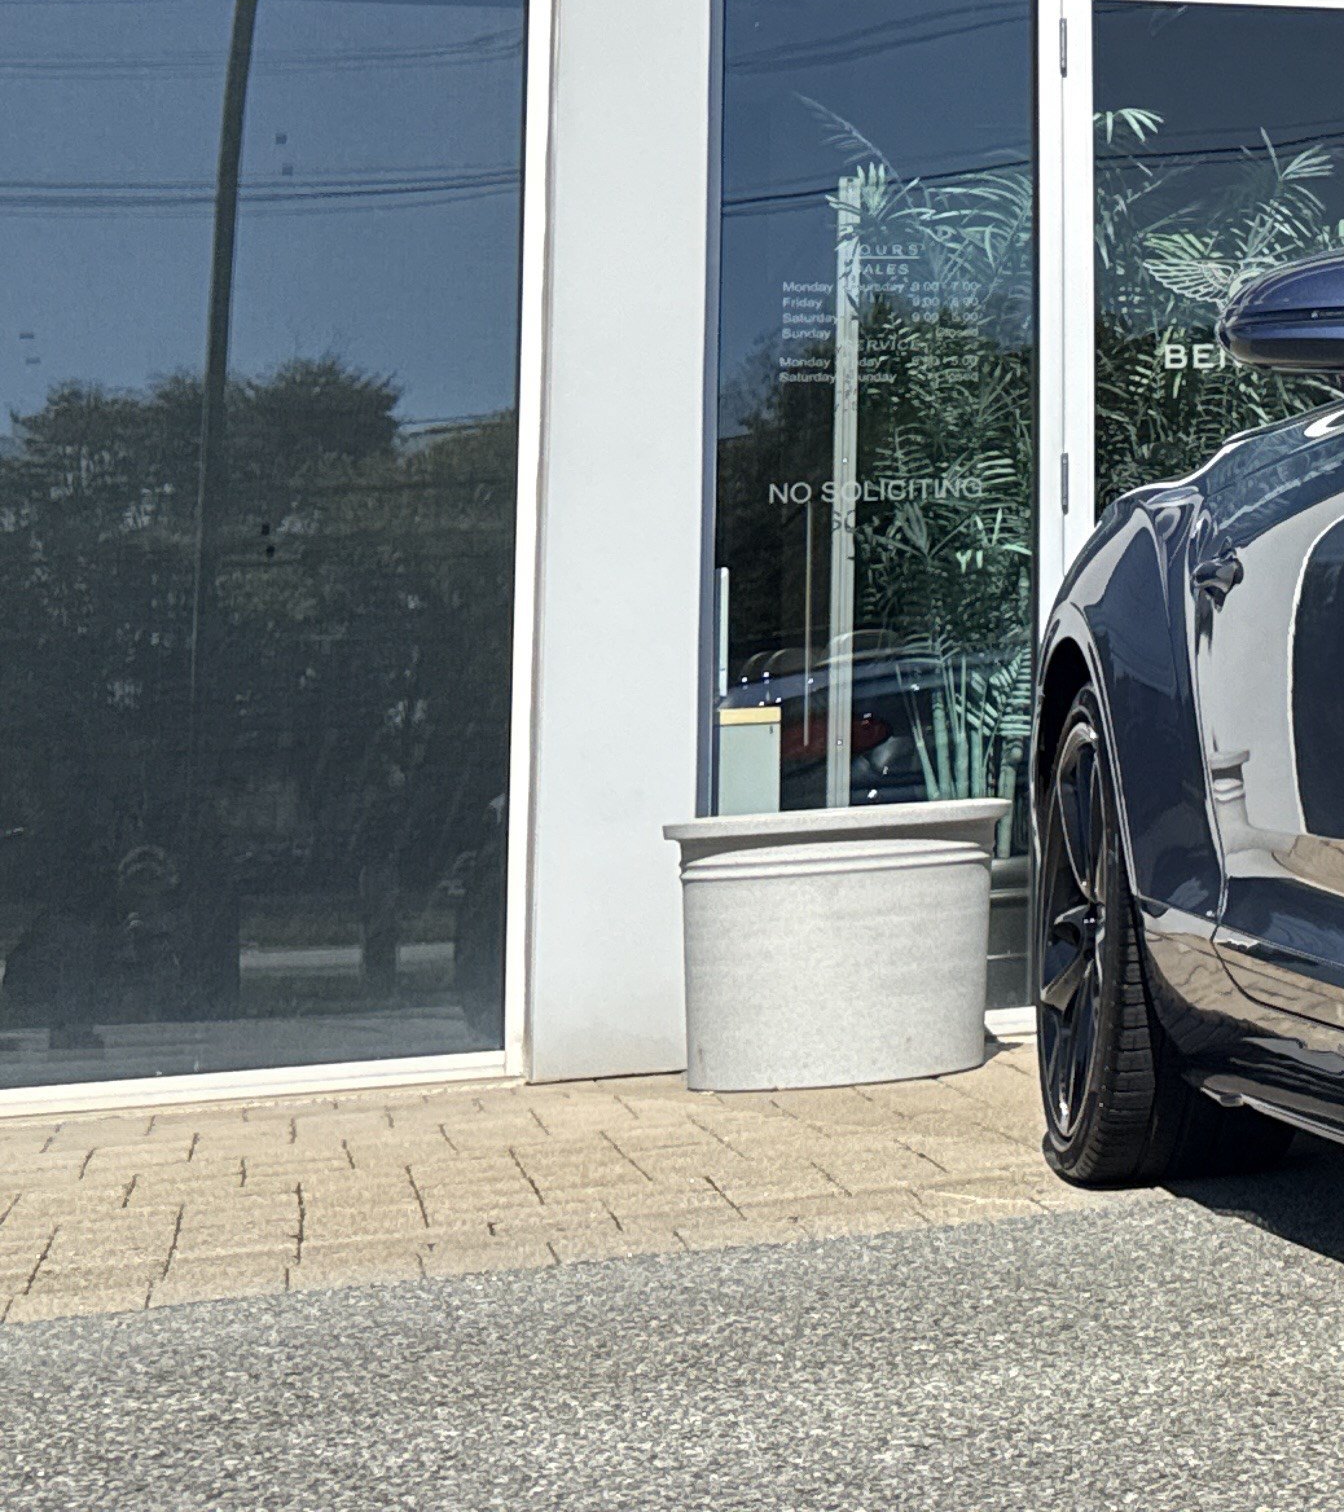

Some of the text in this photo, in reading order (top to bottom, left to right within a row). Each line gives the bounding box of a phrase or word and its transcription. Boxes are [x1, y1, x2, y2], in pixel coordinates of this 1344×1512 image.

[858, 244, 919, 256] OURS
[862, 263, 910, 275] ALES
[782, 282, 833, 294] Monday
[782, 298, 823, 310] Friday
[782, 313, 837, 325] Saturday
[781, 328, 831, 340] Sunday
[779, 357, 831, 369] Monday
[779, 373, 836, 384] Saturday
[768, 477, 983, 504] NO SOLICITING
